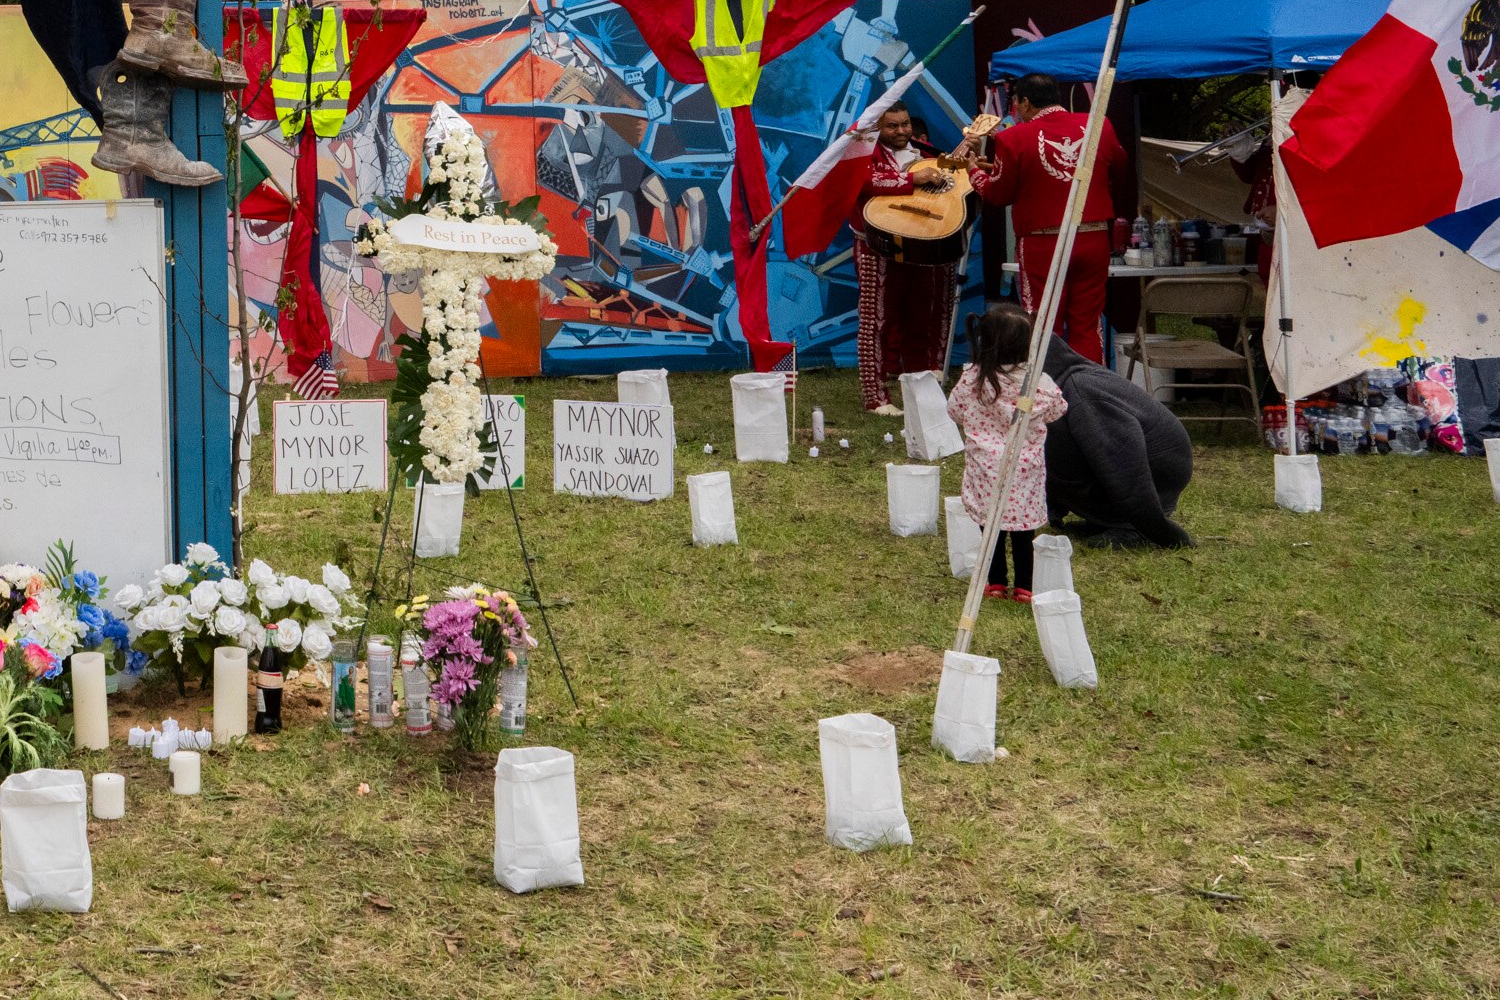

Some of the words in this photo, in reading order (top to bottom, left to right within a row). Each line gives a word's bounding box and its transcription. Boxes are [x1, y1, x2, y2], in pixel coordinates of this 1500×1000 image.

[424, 224, 456, 243] Rest
[461, 230, 477, 244] in
[481, 231, 527, 247] Peace
[25, 290, 153, 335] Flowers
[289, 403, 355, 427] JOSE
[568, 405, 663, 438] MAYNOR
[4, 429, 61, 460] Vigilia
[280, 434, 370, 459] MYNOR
[556, 442, 605, 465] YASSIR
[614, 446, 660, 467] SUAZO
[35, 468, 62, 488] de
[289, 464, 370, 490] LOPEZ
[563, 467, 660, 495] SANDOVAL
